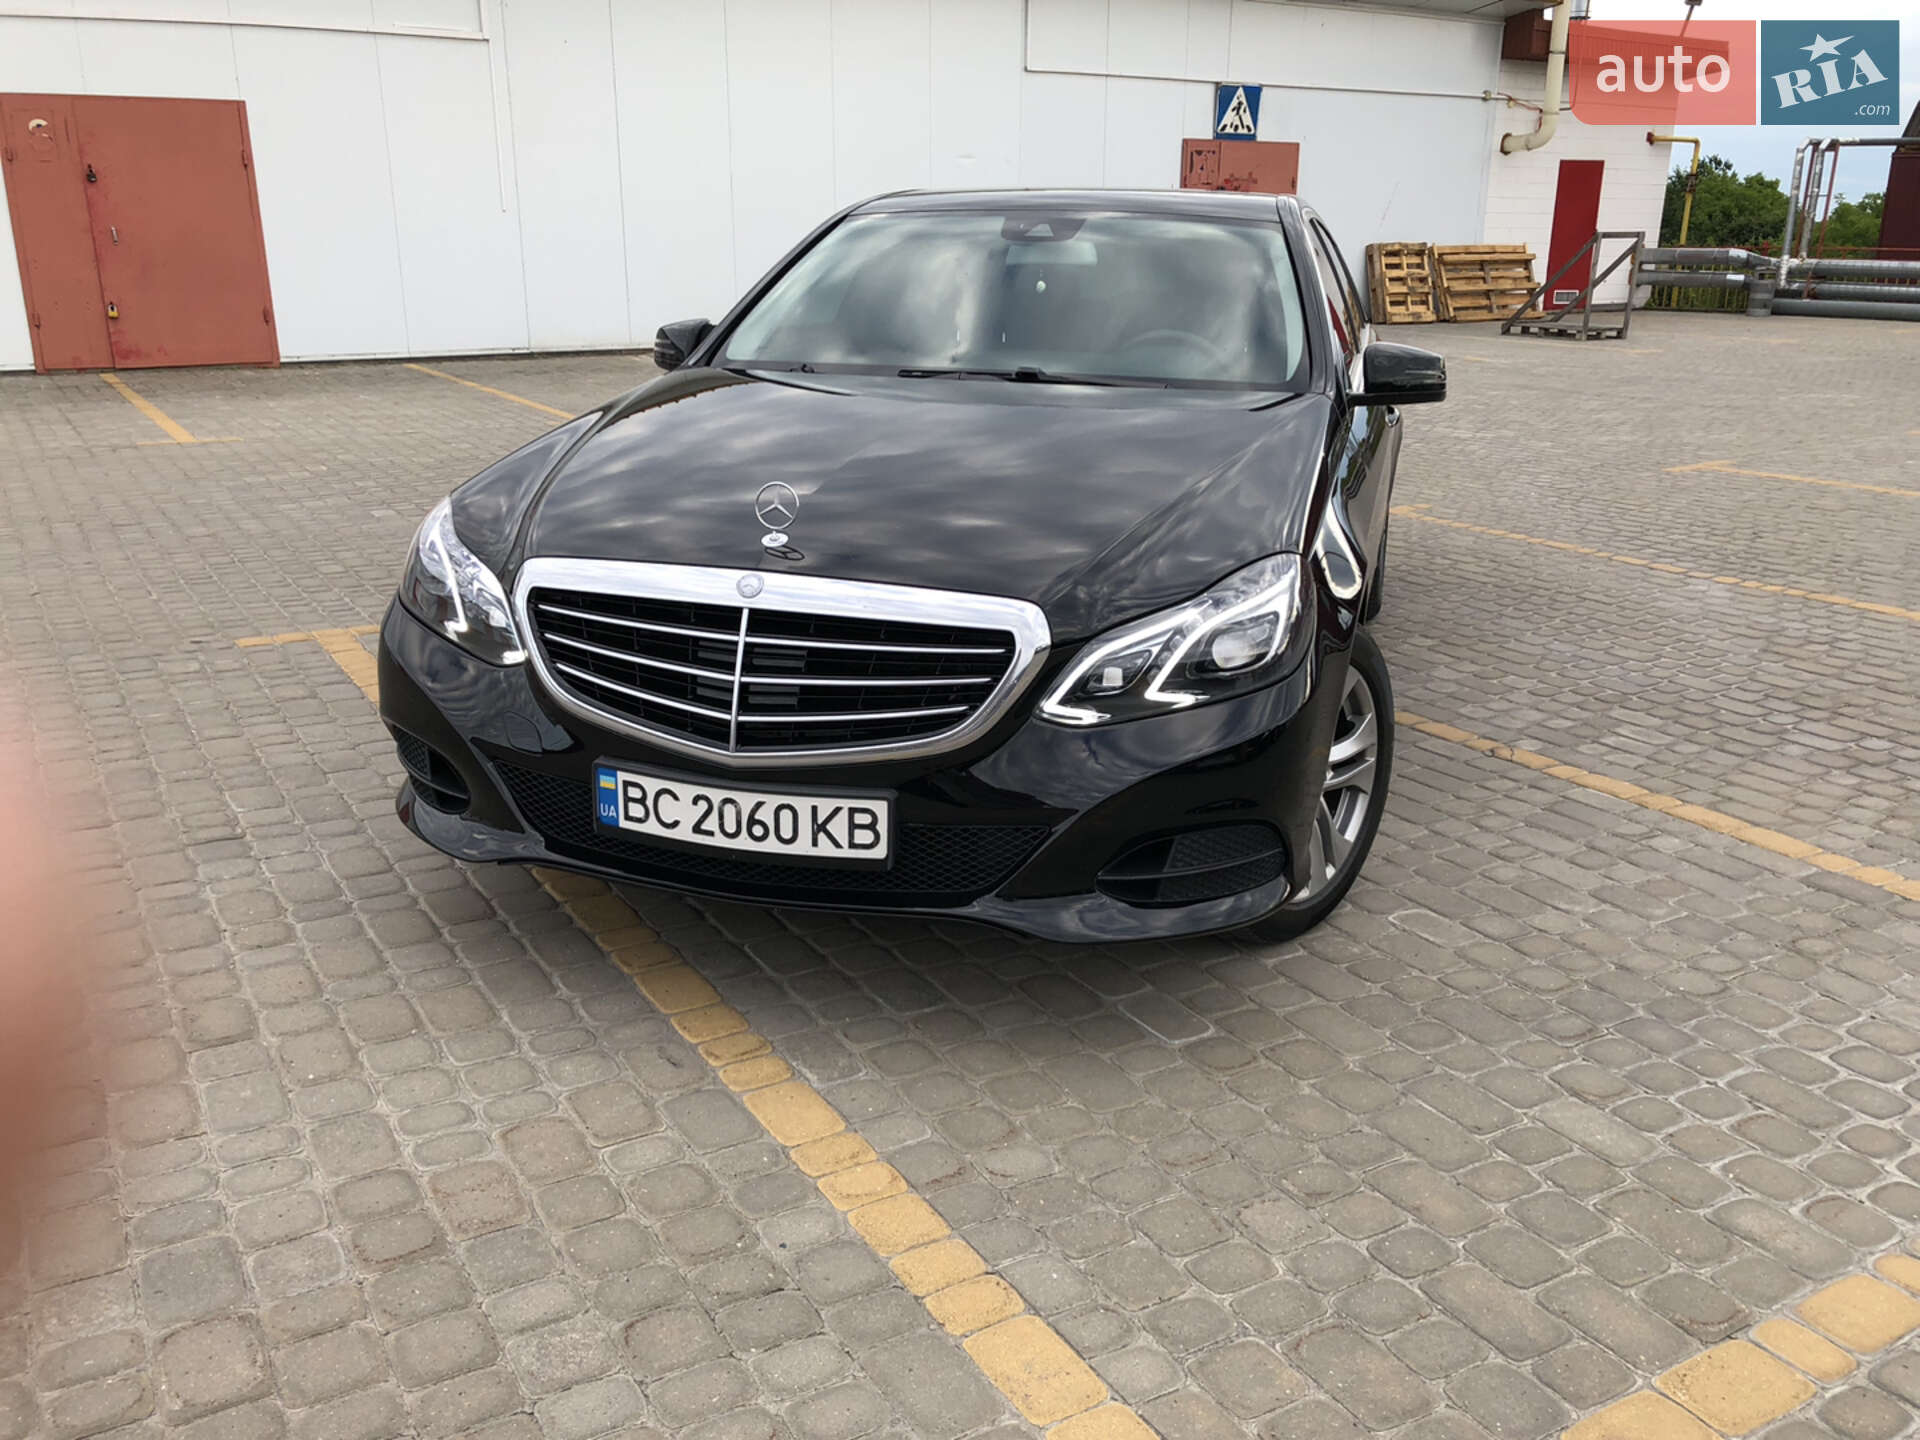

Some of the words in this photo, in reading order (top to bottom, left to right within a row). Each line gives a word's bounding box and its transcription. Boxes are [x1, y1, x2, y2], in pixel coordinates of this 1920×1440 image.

[600, 803, 617, 818] UA
[622, 780, 681, 830] BC
[691, 794, 799, 846] 2060
[810, 805, 881, 850] KB
